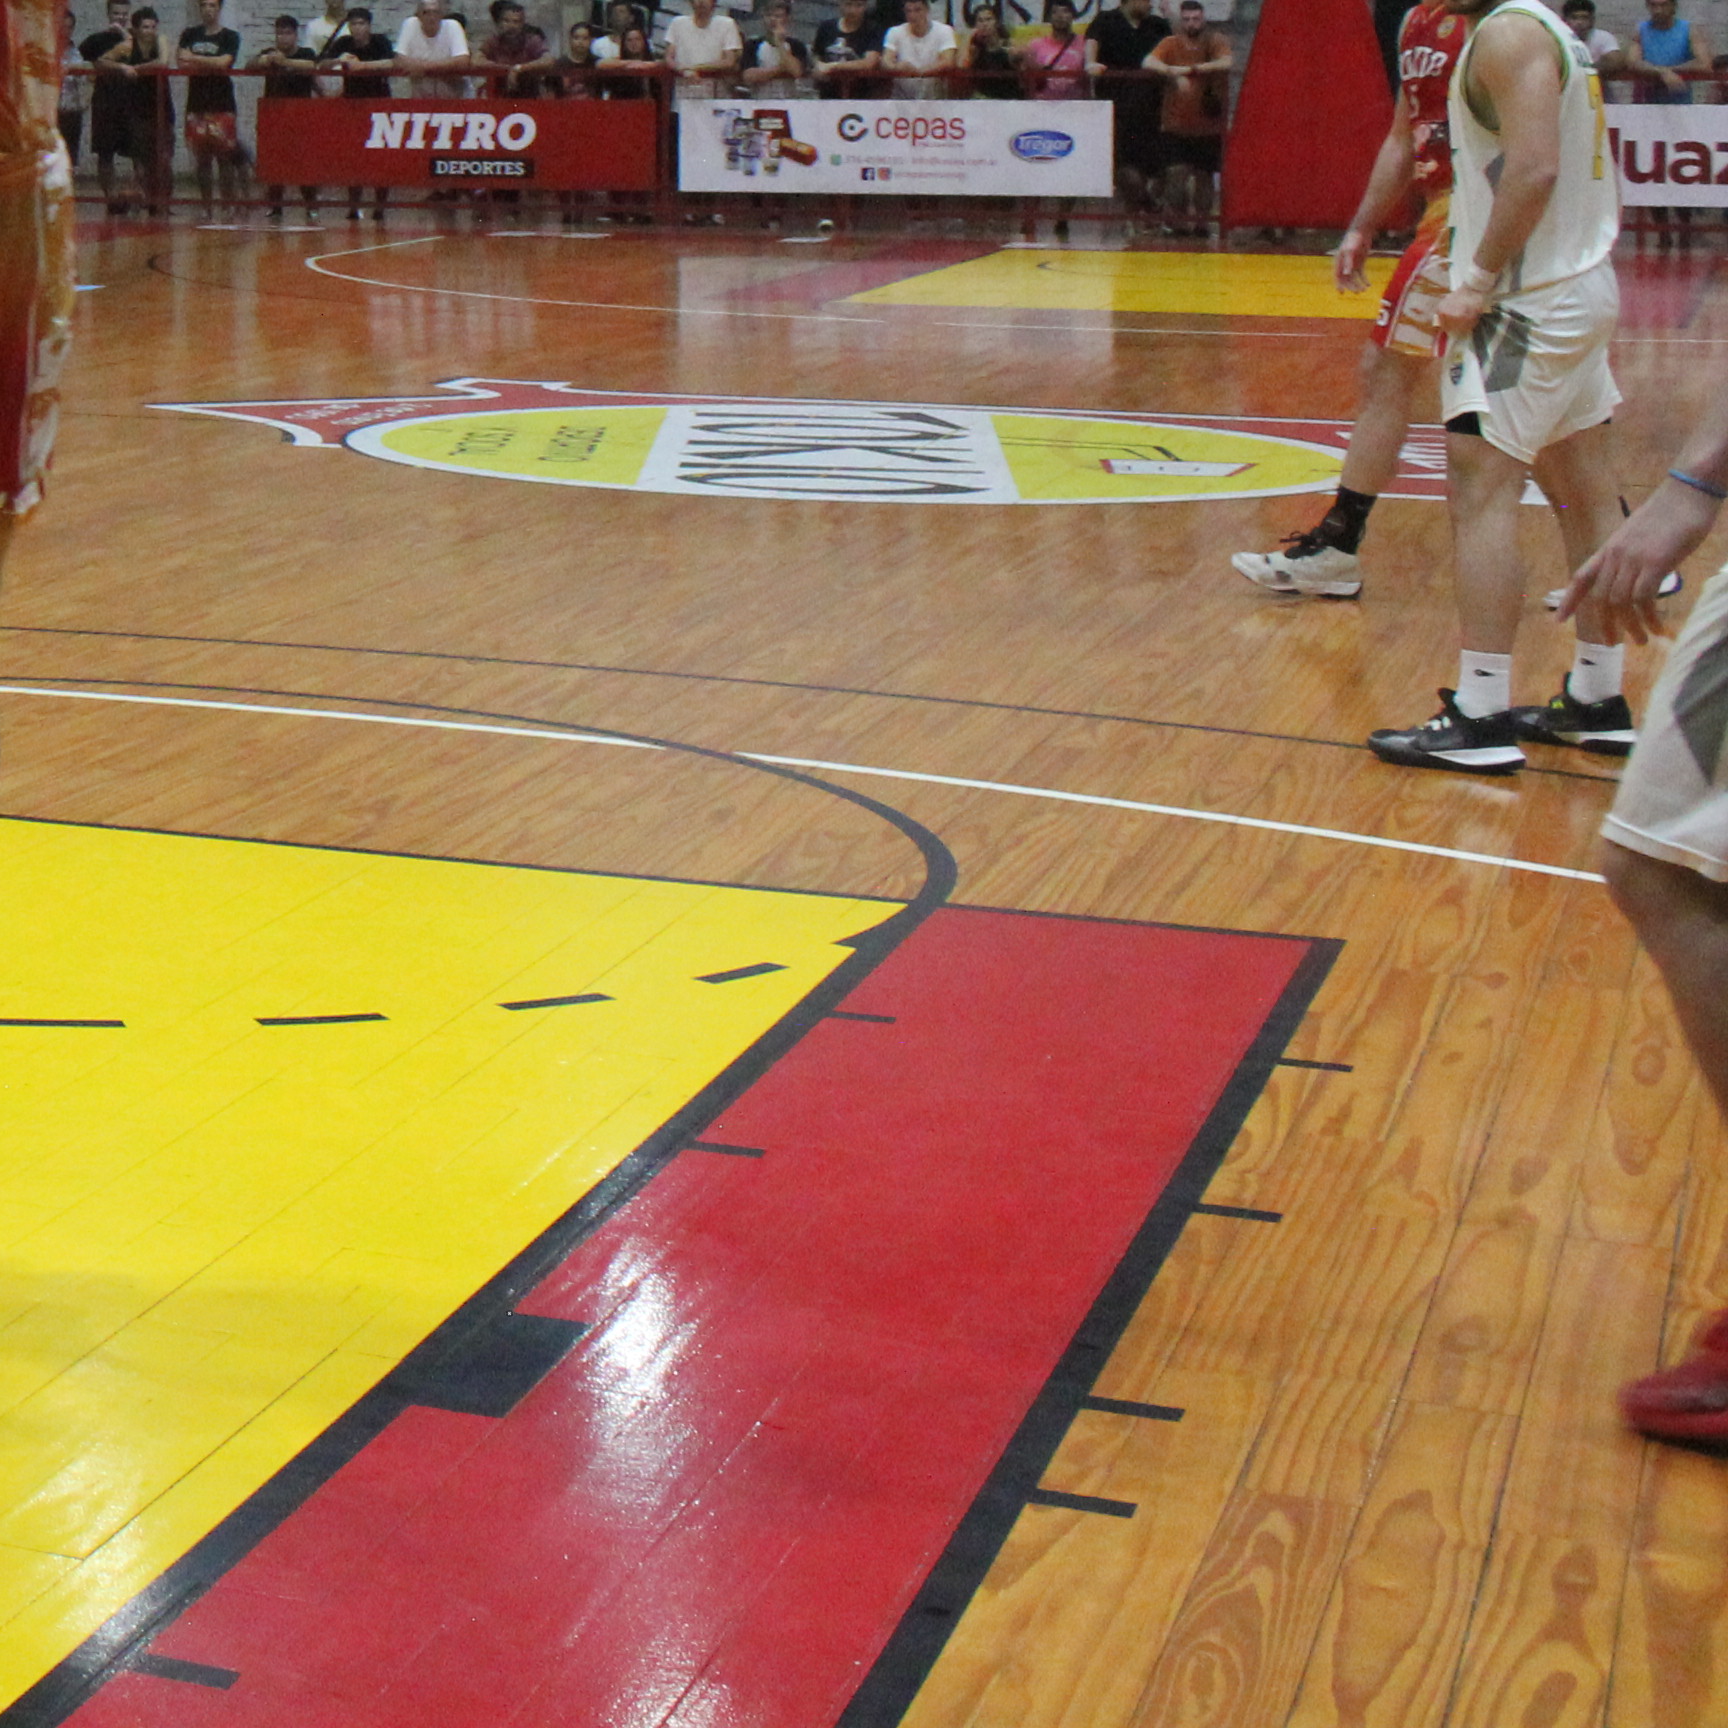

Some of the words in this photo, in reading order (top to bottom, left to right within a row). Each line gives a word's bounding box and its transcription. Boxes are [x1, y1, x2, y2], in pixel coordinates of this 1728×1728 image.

[364, 112, 537, 152] NITRO
[875, 116, 966, 147] cepas
[435, 160, 525, 176] DEPORTES
